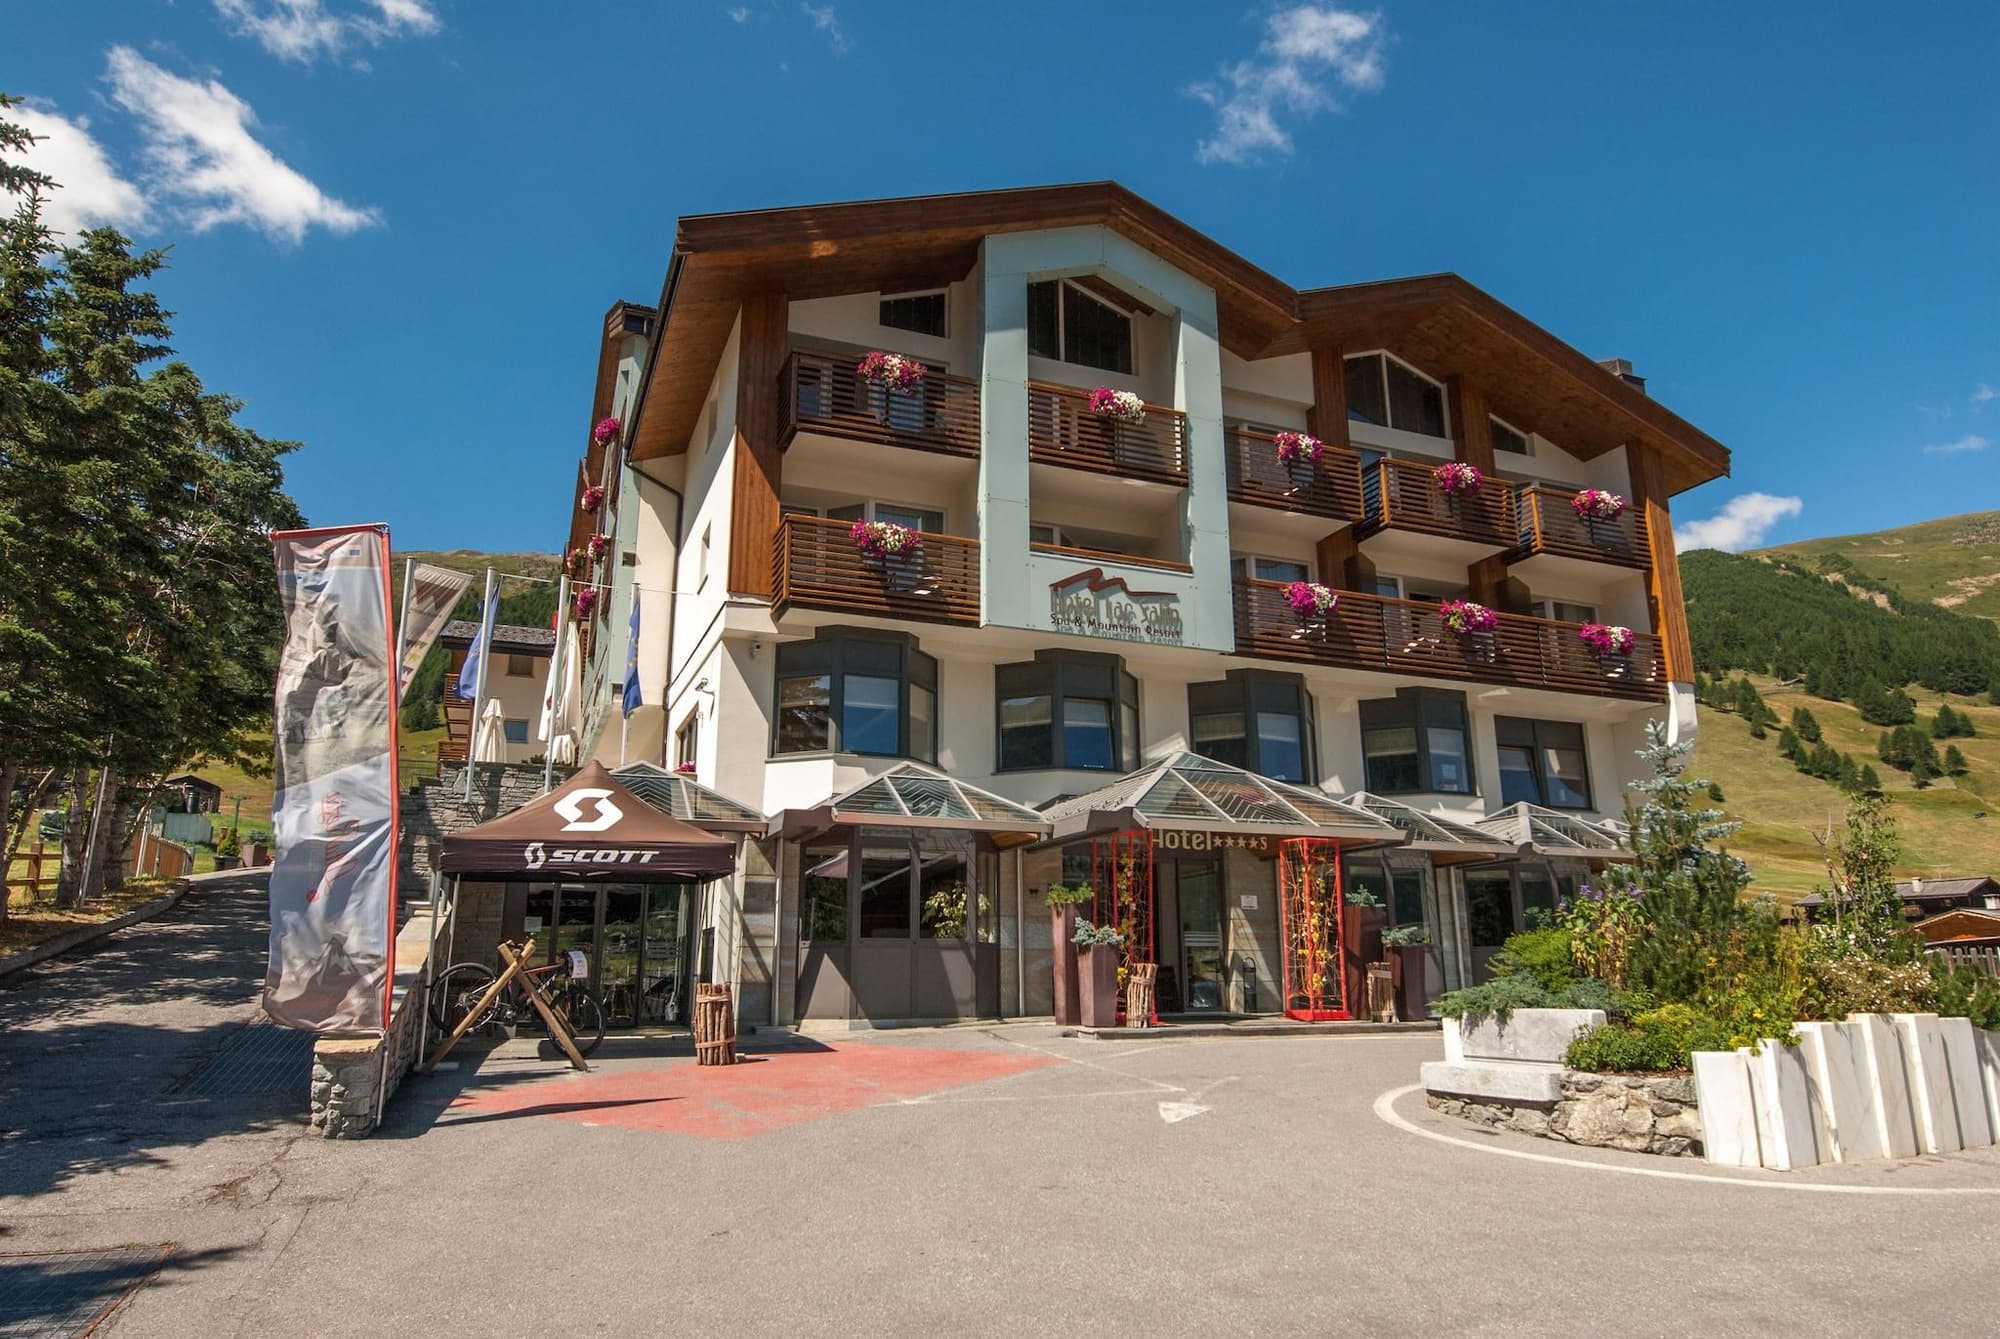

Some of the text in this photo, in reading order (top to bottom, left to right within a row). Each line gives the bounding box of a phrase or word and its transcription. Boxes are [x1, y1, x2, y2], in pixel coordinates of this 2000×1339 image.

[1050, 612, 1181, 639] Spa & Mountain Resort
[1152, 828, 1212, 850] Hotel
[549, 850, 660, 864] SCOTT
